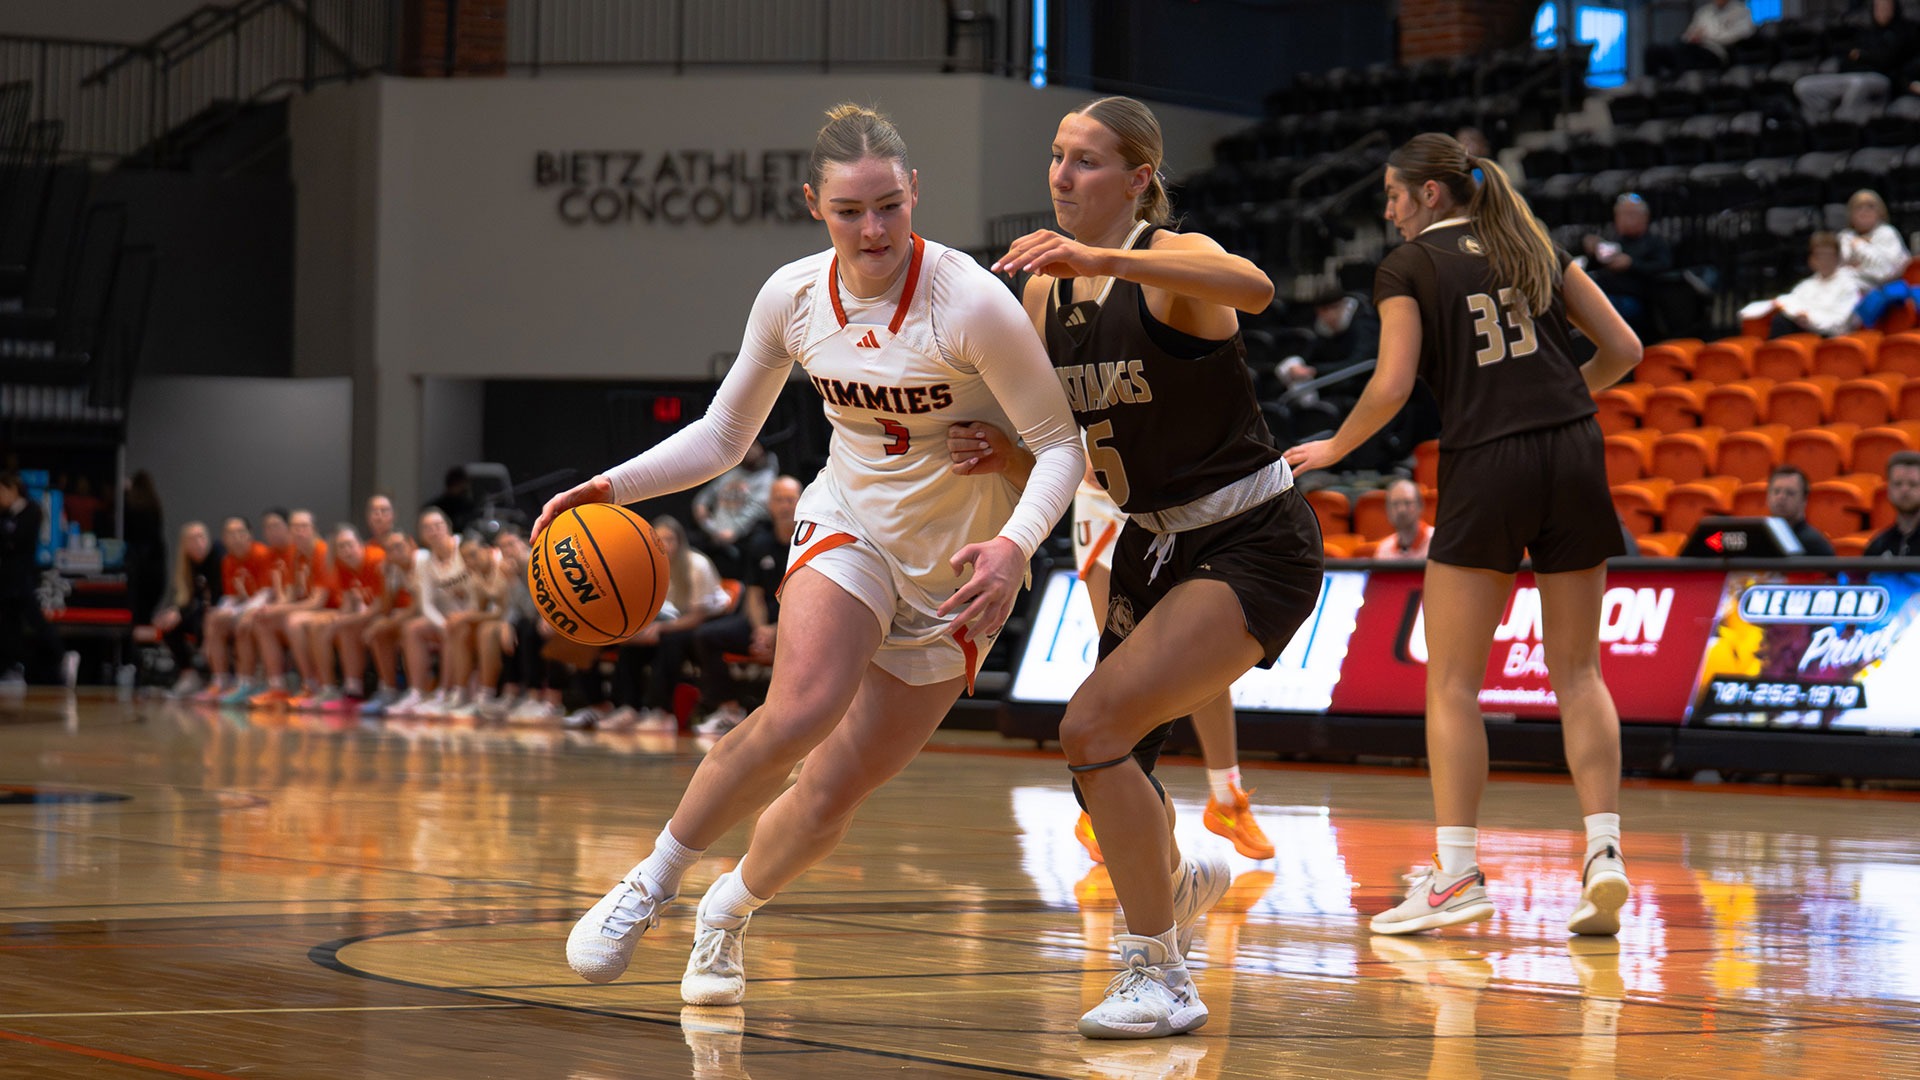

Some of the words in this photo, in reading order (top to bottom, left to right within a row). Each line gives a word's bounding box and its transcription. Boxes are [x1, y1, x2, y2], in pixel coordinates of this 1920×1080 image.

[534, 150, 644, 186] BIETZ
[653, 150, 810, 184] ATHLET
[558, 187, 818, 224] CONCOURS
[1466, 287, 1538, 367] 33
[554, 535, 602, 605] NCAA
[532, 545, 579, 636] Wilson
[1747, 589, 1882, 616] NEWMAN
[1711, 681, 1860, 707] 701-252-1970
